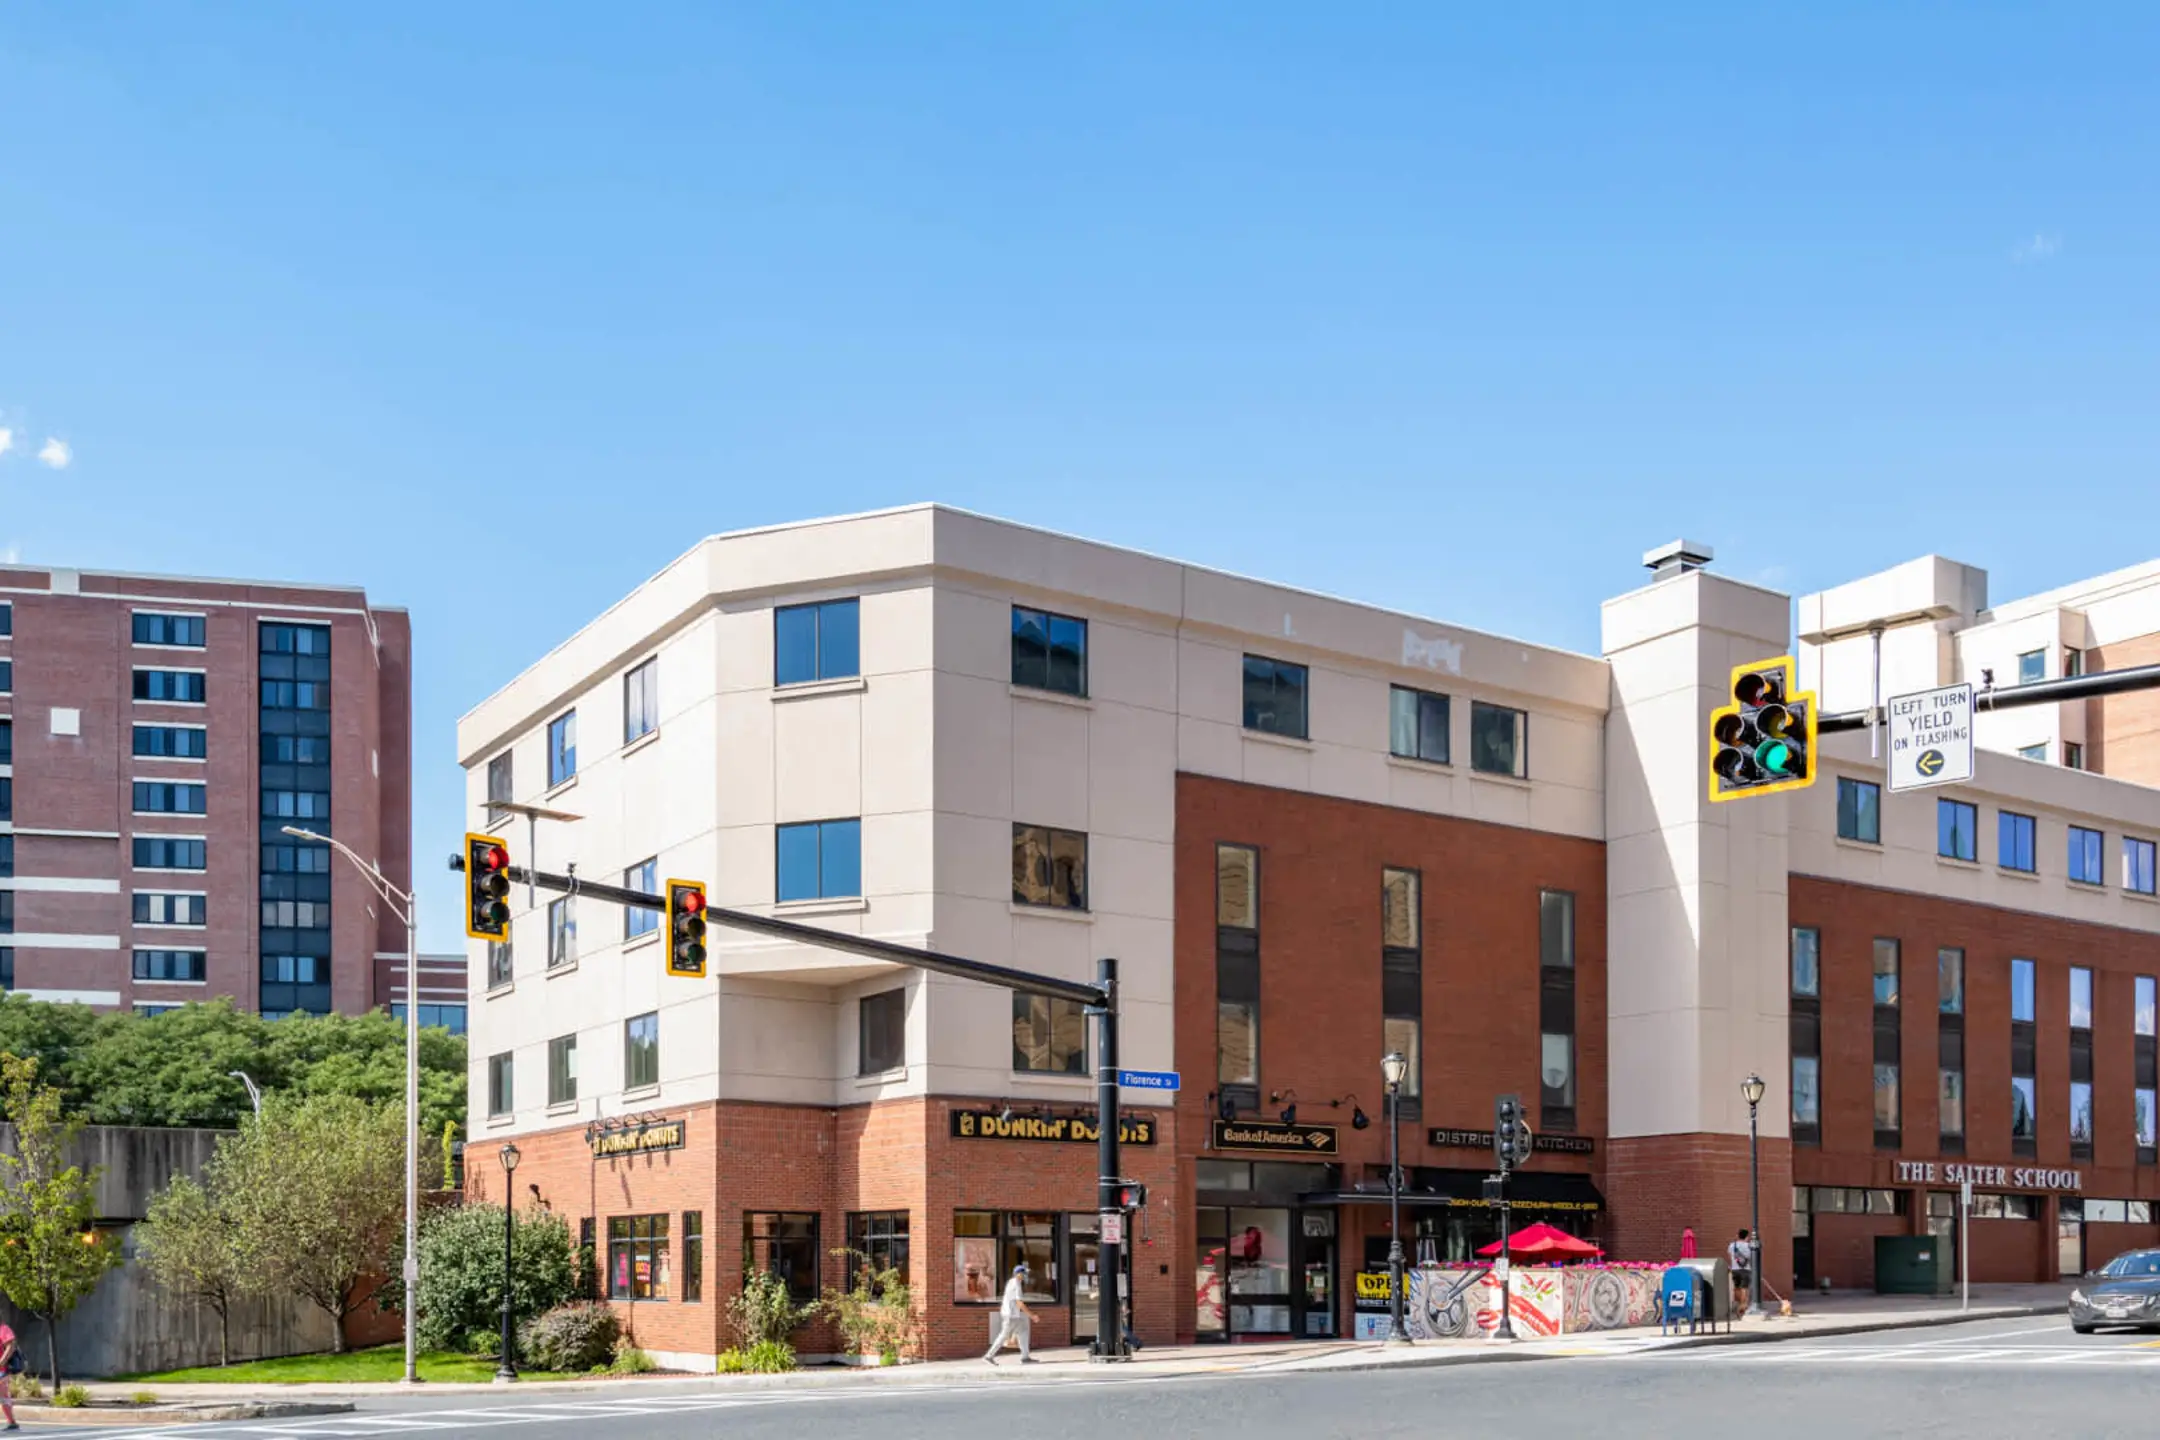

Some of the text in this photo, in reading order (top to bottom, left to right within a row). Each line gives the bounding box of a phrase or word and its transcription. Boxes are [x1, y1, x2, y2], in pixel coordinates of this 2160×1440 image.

[1893, 691, 1967, 716] LEFT TURN
[1908, 711, 1953, 731] YIELD
[1894, 727, 1968, 751] ON FLASHING
[1124, 1073, 1162, 1086] Florence
[1262, 1130, 1304, 1145] America
[1436, 1131, 1593, 1152] DISTRIC KITCHEN
[1899, 1162, 2082, 1190] THE SALTER SCHOOL
[1364, 1278, 1392, 1289] OPE
